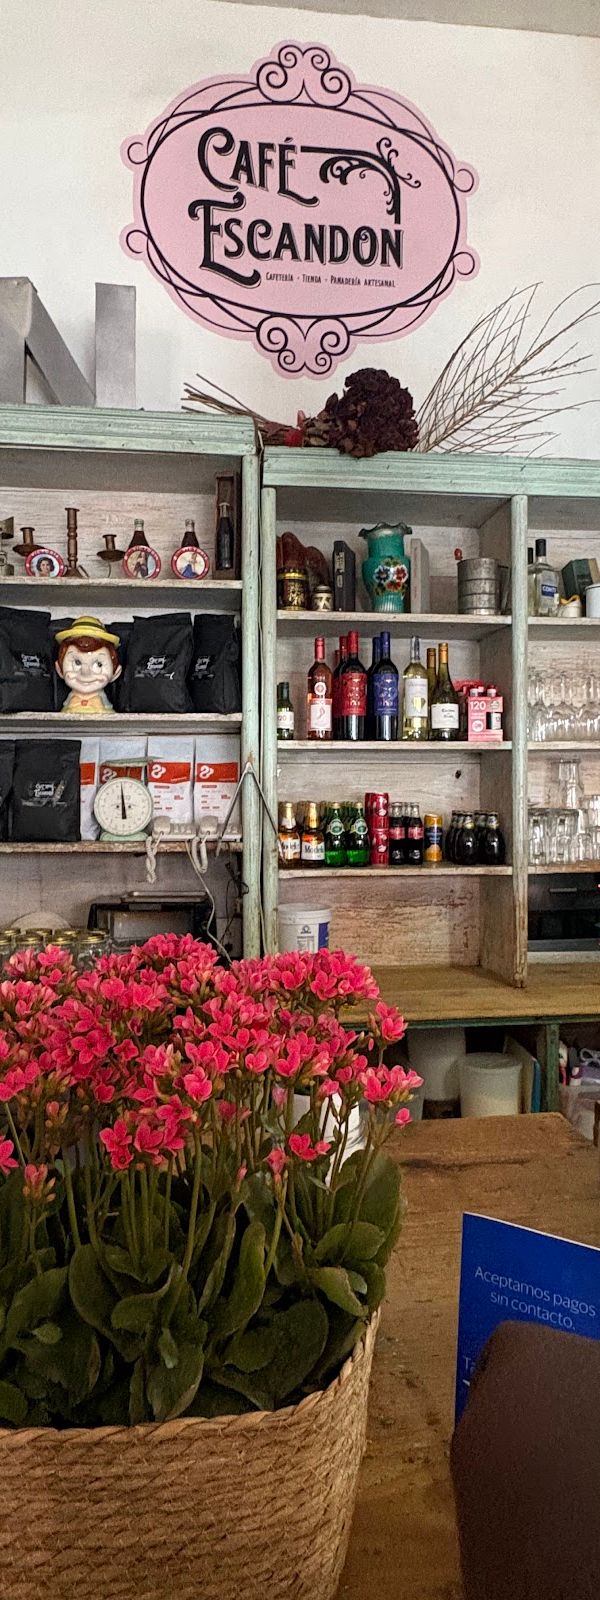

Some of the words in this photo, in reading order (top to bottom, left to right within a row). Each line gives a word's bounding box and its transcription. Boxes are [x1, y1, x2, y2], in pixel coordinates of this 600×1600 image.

[197, 126, 320, 207] CAFÉ
[188, 191, 404, 289] ESCANDON
[302, 273, 322, 284] TIENDA
[470, 700, 487, 711] 120
[474, 1266, 551, 1302] Aceptamos
[553, 1293, 597, 1317] pagos
[490, 1292, 509, 1306] sin
[511, 1299, 576, 1330] contacto.
